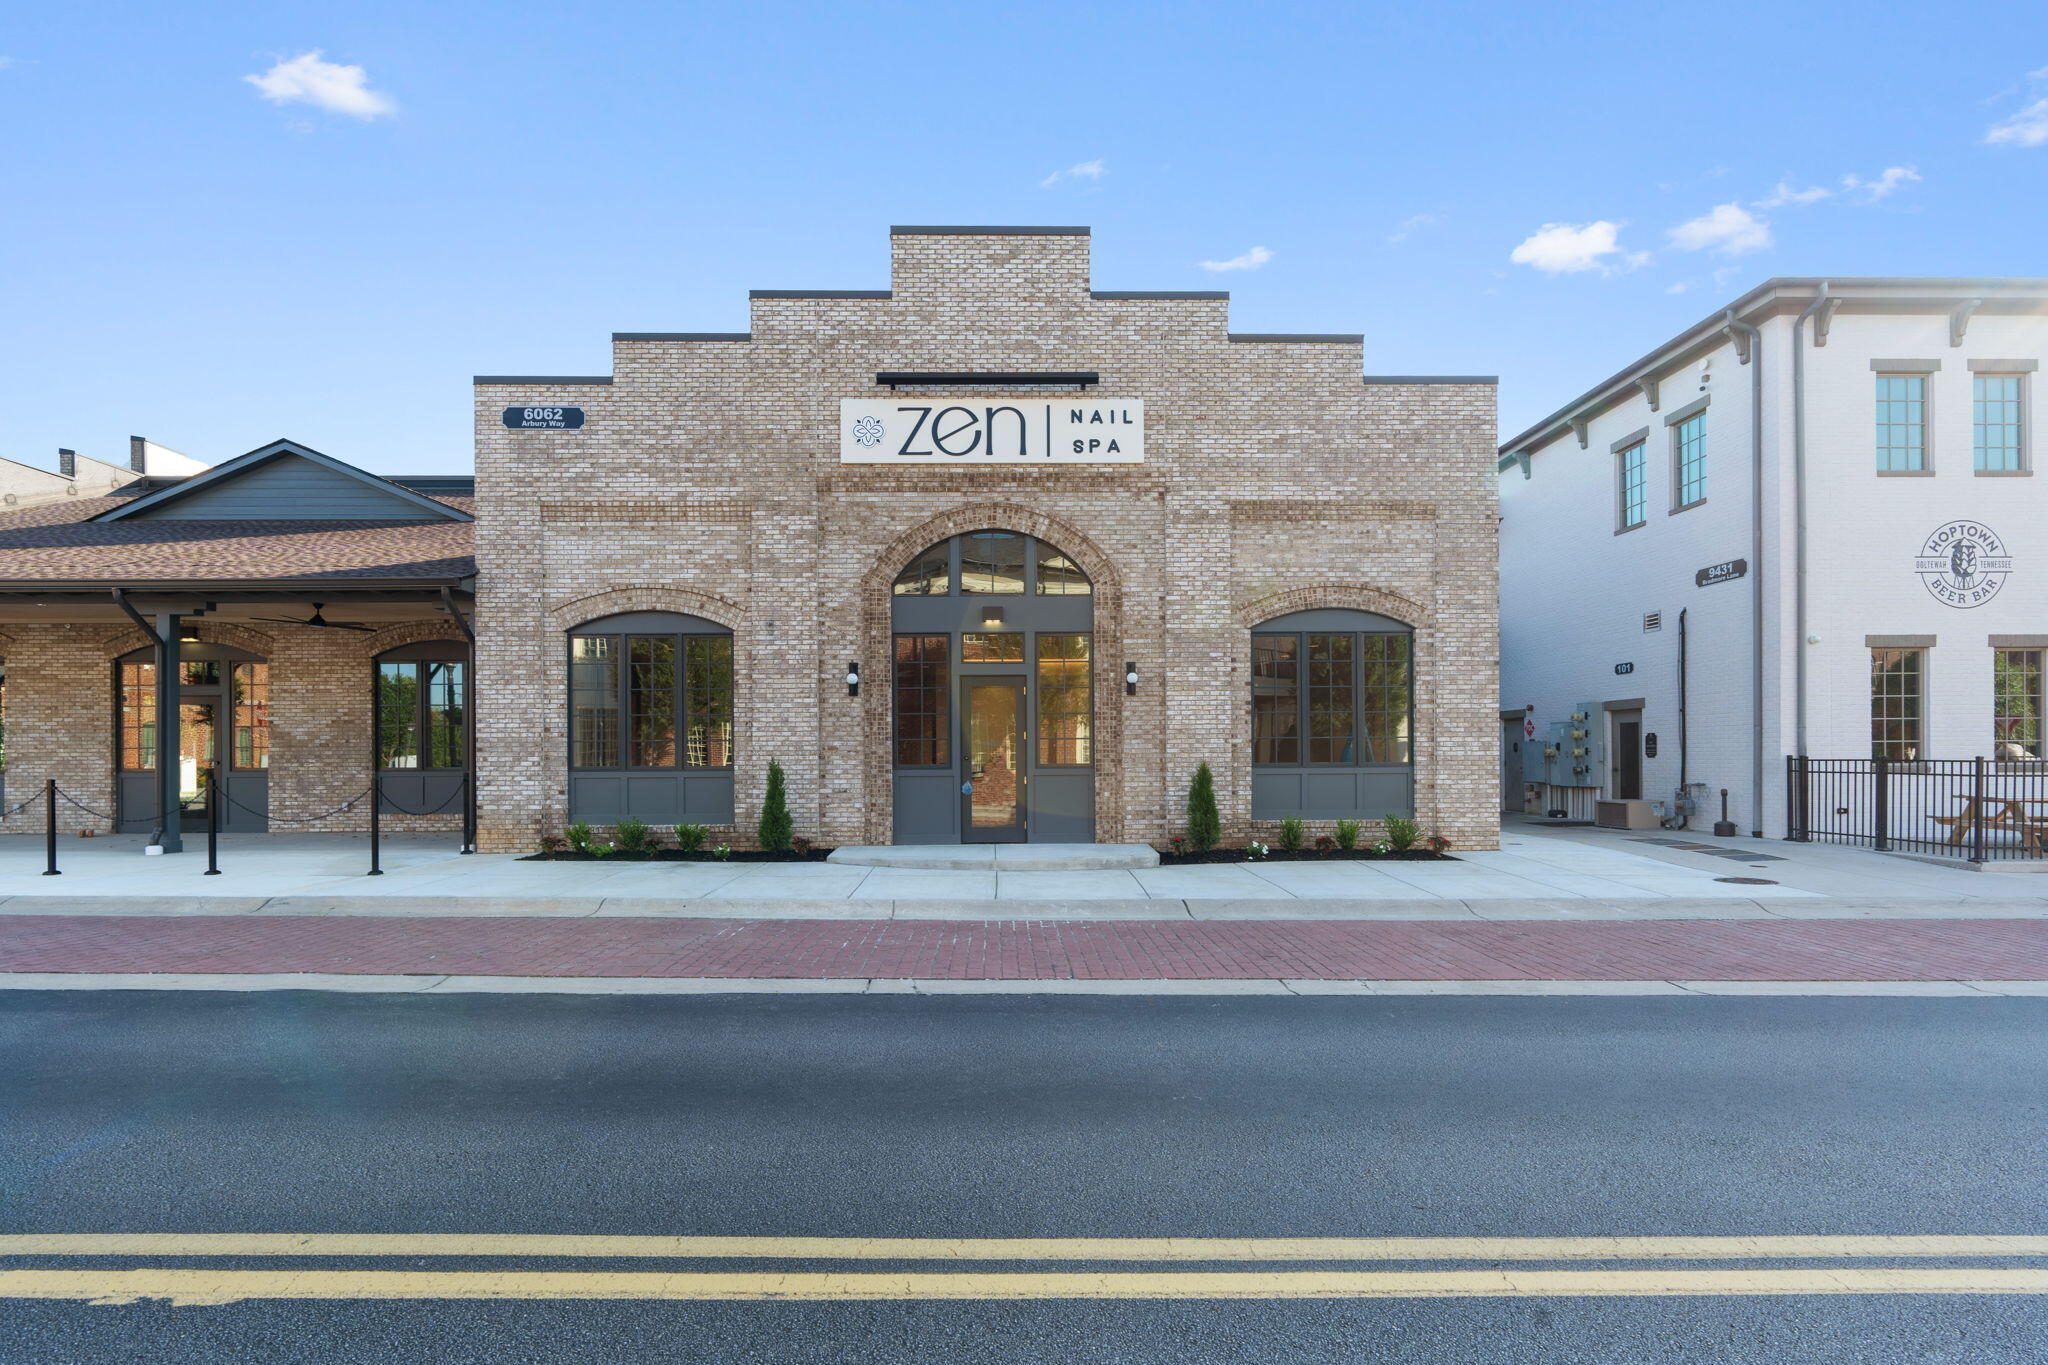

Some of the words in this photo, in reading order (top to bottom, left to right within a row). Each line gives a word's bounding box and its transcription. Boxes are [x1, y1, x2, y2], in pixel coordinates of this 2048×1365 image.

[524, 408, 563, 420] 6062
[1070, 409, 1133, 425] NAIL
[897, 406, 1027, 456] zen
[1072, 438, 1121, 454] SPA
[1928, 524, 1998, 552] HOPTOWN
[1708, 562, 1732, 578] 9431
[1980, 560, 2012, 569] TENNESSEE
[1932, 579, 1966, 604] BEER
[1971, 579, 1998, 602] BAR
[1617, 664, 1630, 674] 101
